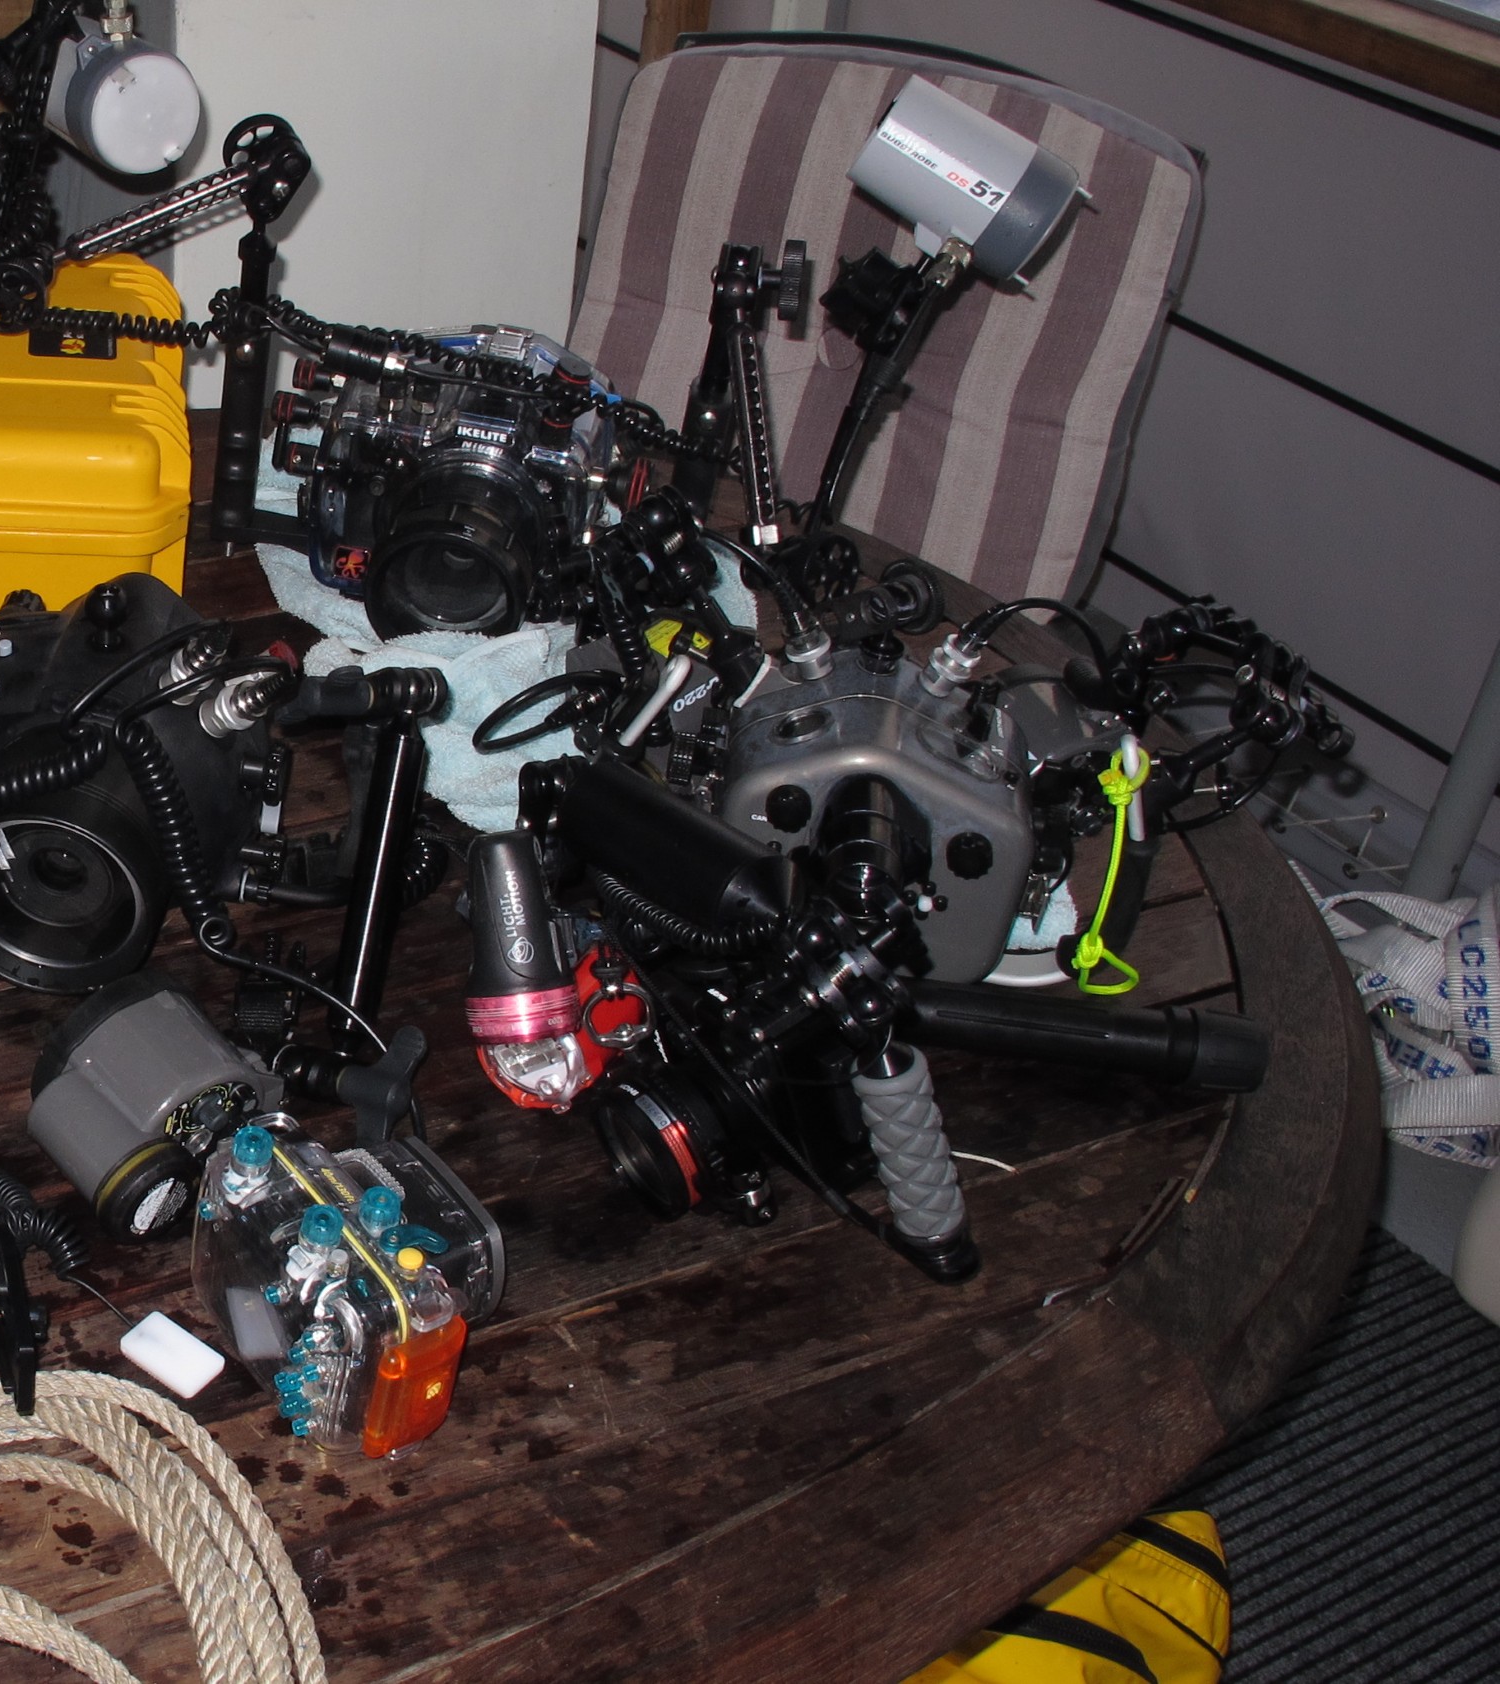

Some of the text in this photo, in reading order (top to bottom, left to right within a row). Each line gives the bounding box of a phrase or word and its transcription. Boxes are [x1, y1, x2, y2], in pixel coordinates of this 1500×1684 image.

[879, 130, 1005, 207] SUBSTROBE DS 51
[457, 426, 507, 443] IKELITE
[505, 870, 527, 926] MOTION
